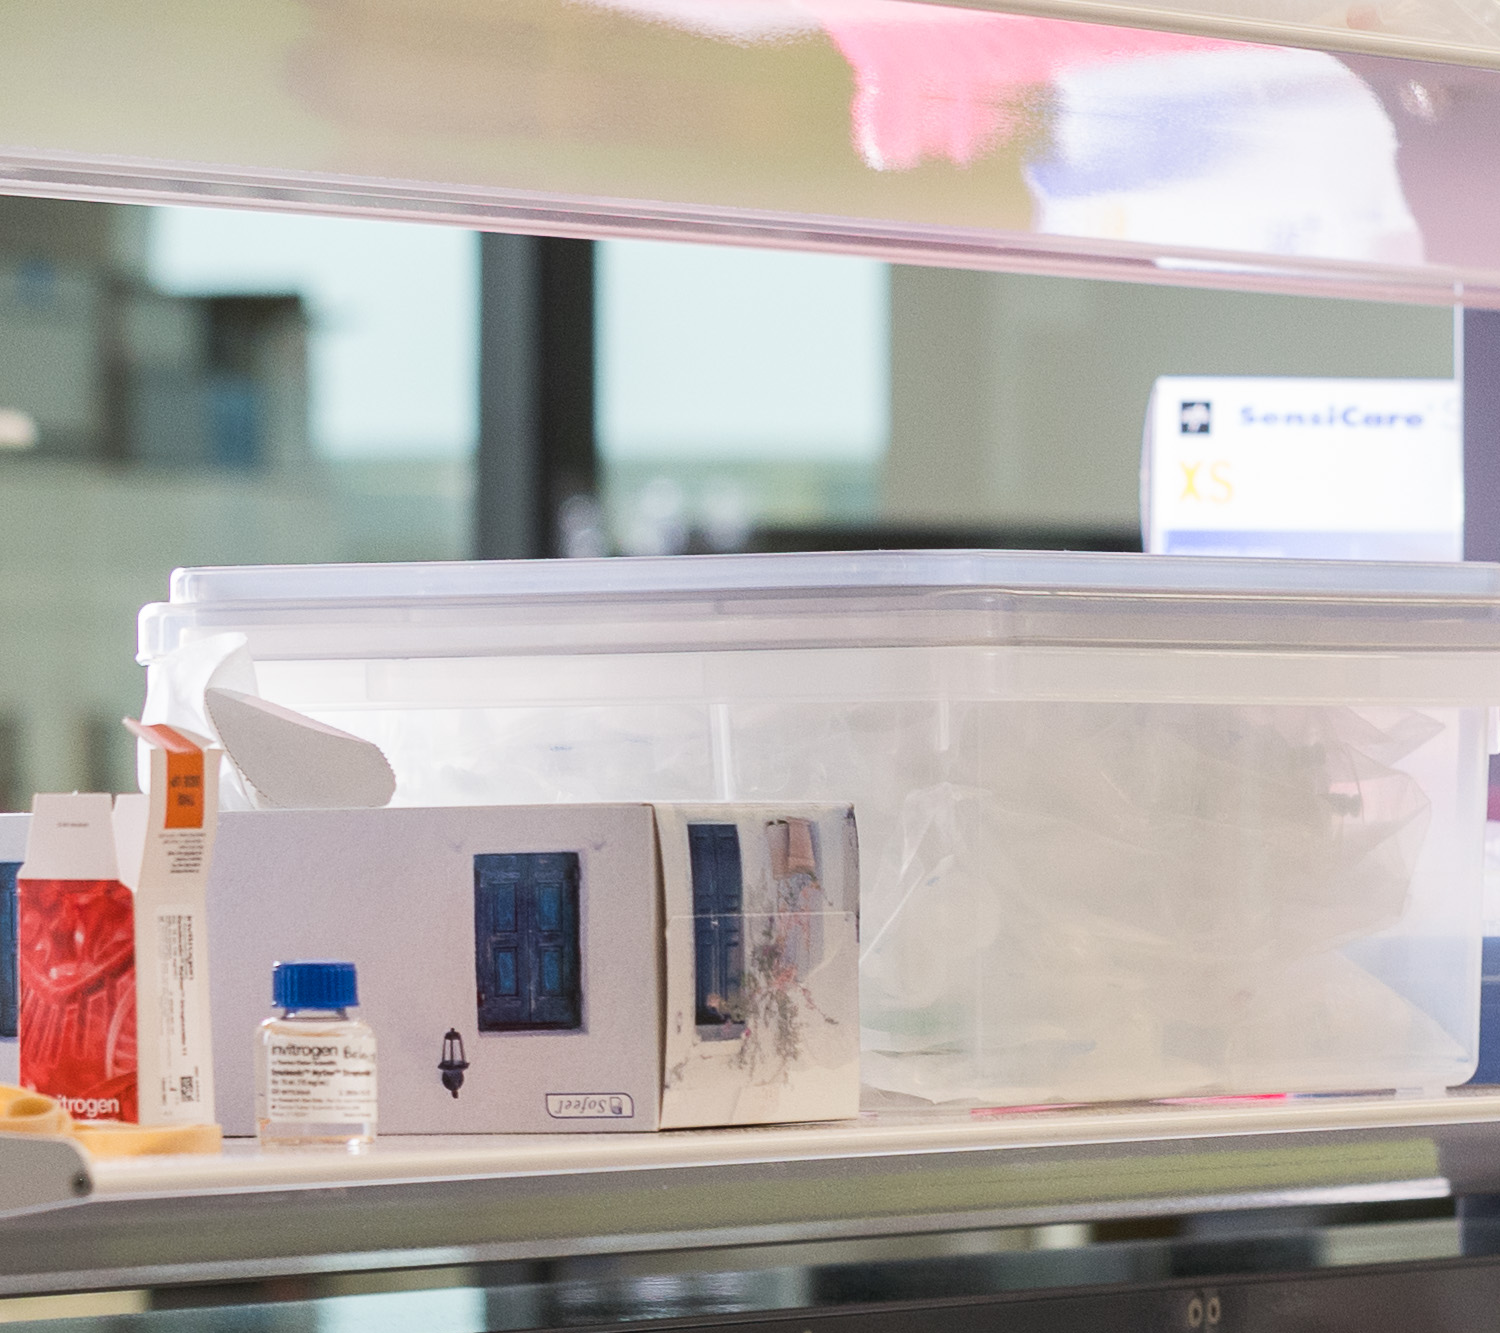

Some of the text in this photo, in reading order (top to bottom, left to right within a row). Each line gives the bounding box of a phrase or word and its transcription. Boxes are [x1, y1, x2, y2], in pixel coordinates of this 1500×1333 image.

[1239, 406, 1425, 427] SensiCare
[1179, 460, 1234, 504] XS
[271, 1044, 339, 1060] nvitrogen
[58, 1094, 120, 1118] itrogen
